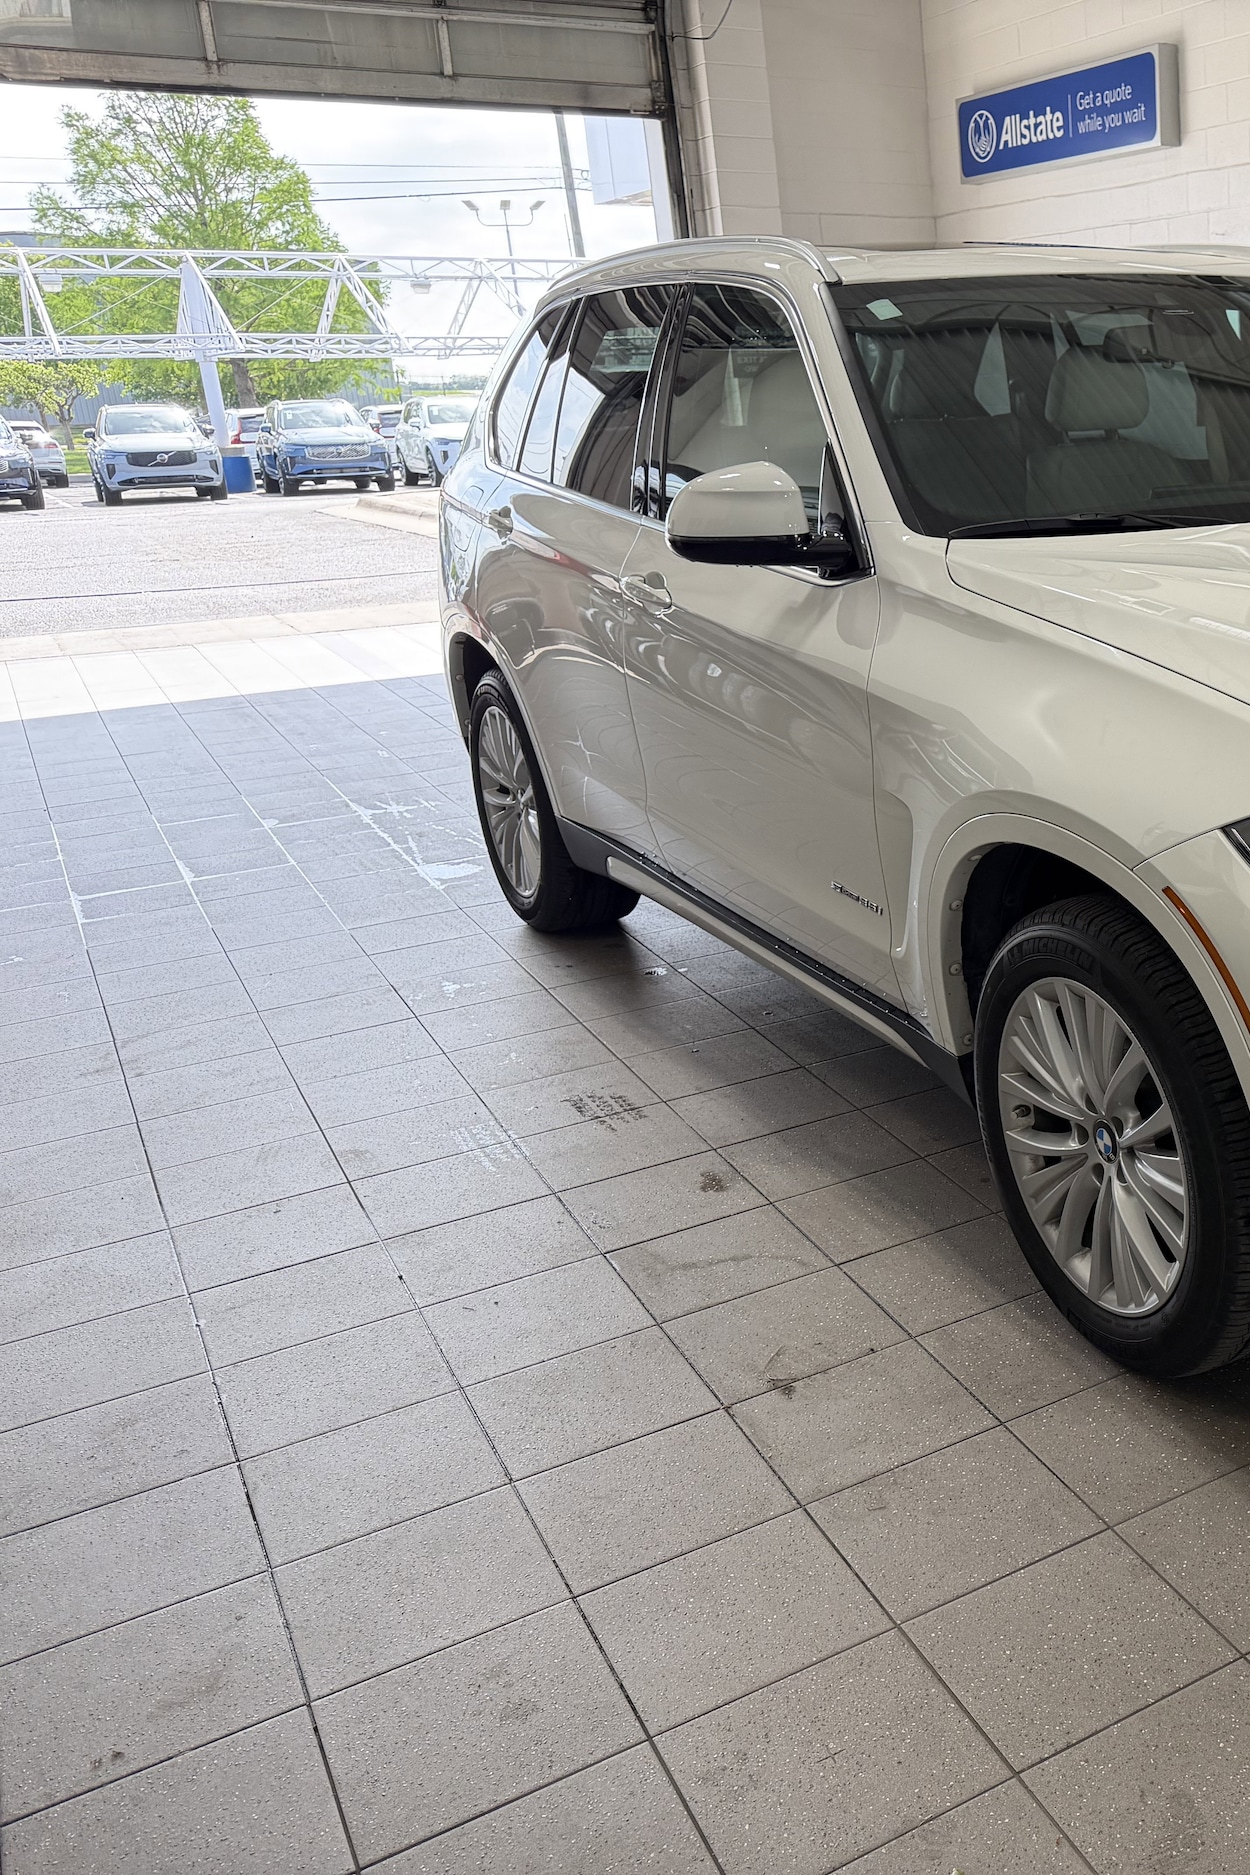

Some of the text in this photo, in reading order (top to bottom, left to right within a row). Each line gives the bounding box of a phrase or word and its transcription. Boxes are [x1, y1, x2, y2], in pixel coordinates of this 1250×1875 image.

[1076, 83, 1132, 110] Get a quote
[999, 107, 1064, 150] Allstate
[1077, 103, 1146, 134] while you wait
[1022, 937, 1094, 971] MICHELIN
